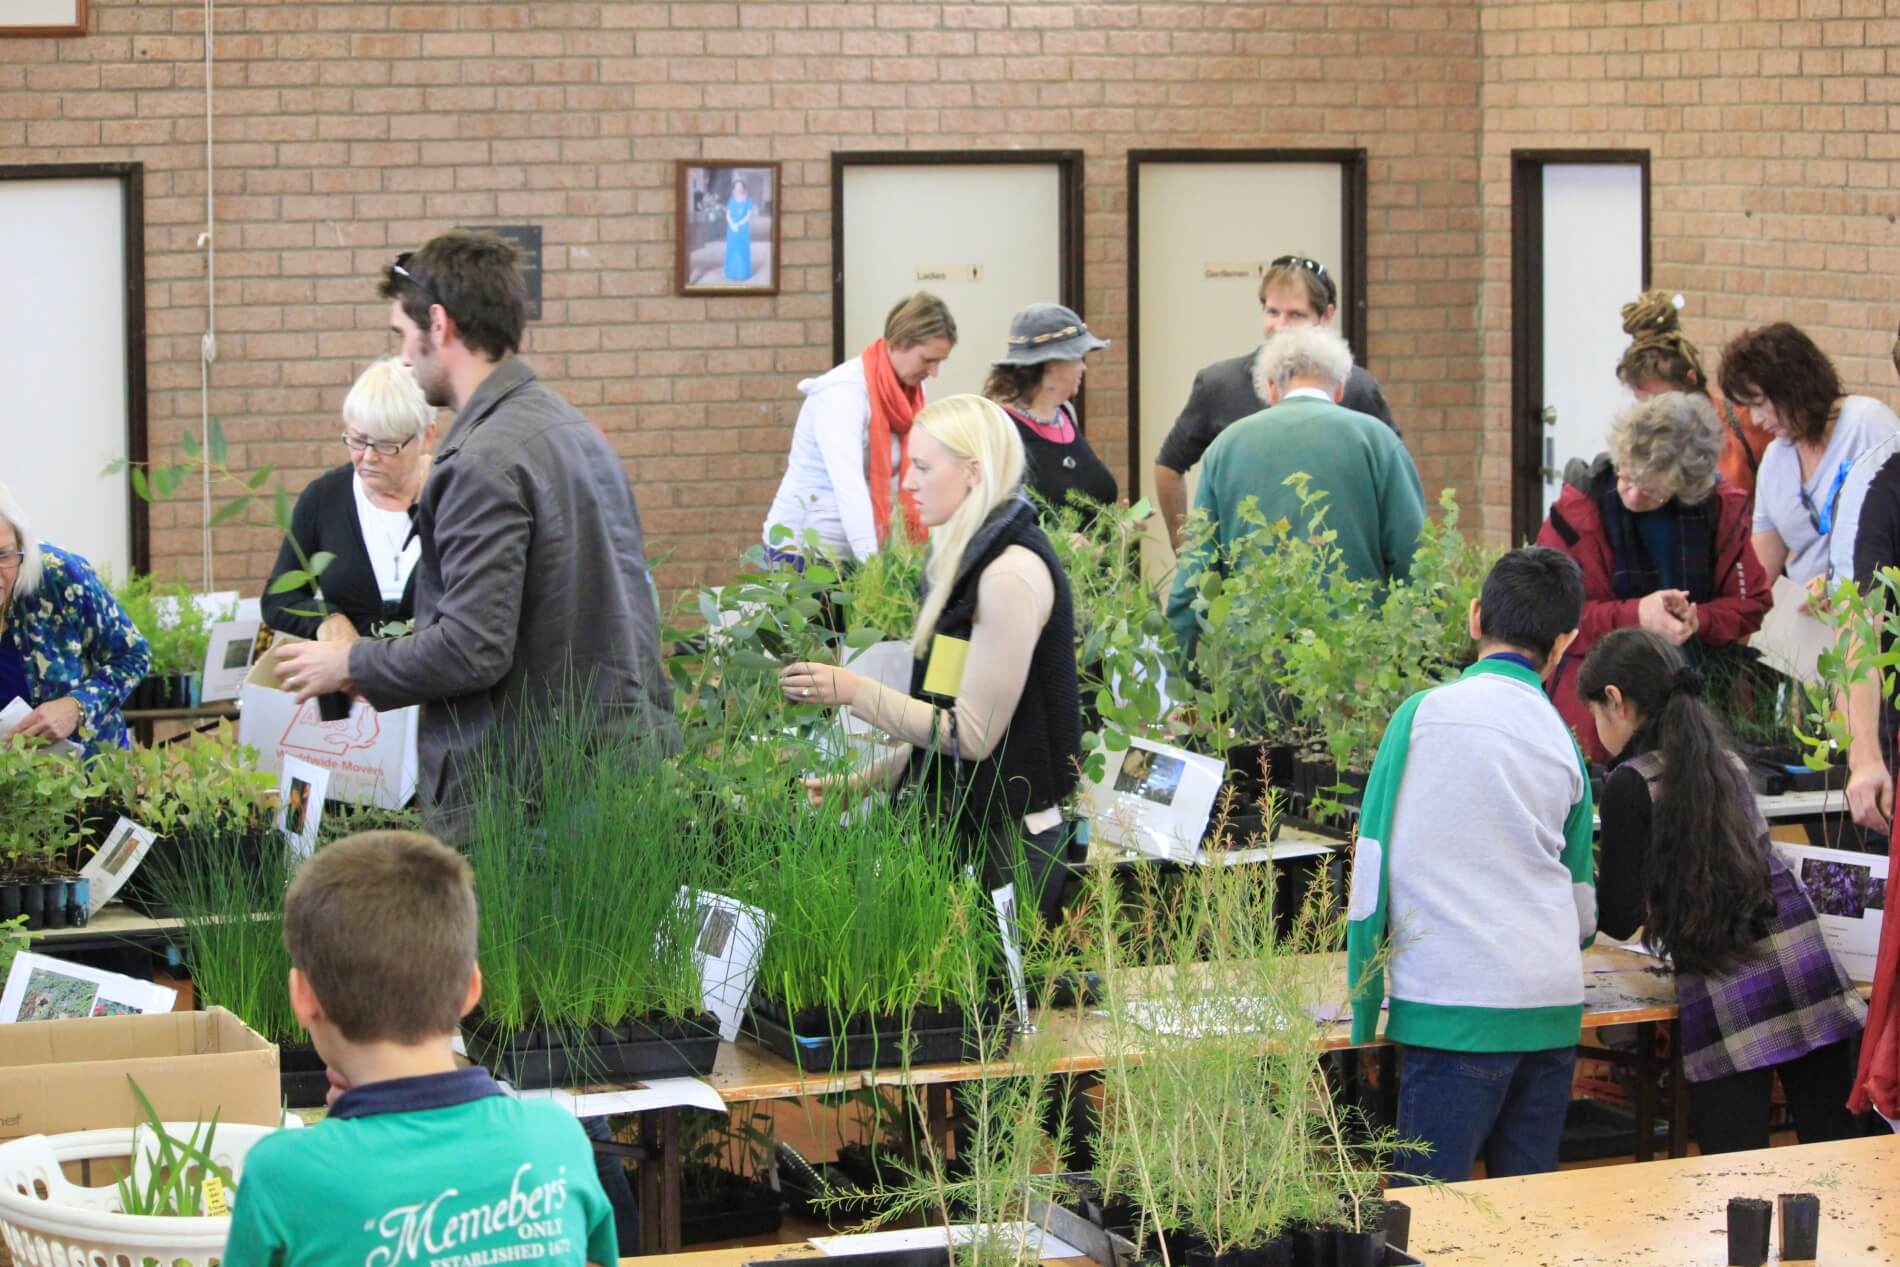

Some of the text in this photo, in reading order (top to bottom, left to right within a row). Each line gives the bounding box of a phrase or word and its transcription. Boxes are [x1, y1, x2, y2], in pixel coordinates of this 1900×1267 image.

[916, 270, 947, 281] Ladies
[342, 760, 384, 777] Movers
[517, 1218, 563, 1240] ONLY
